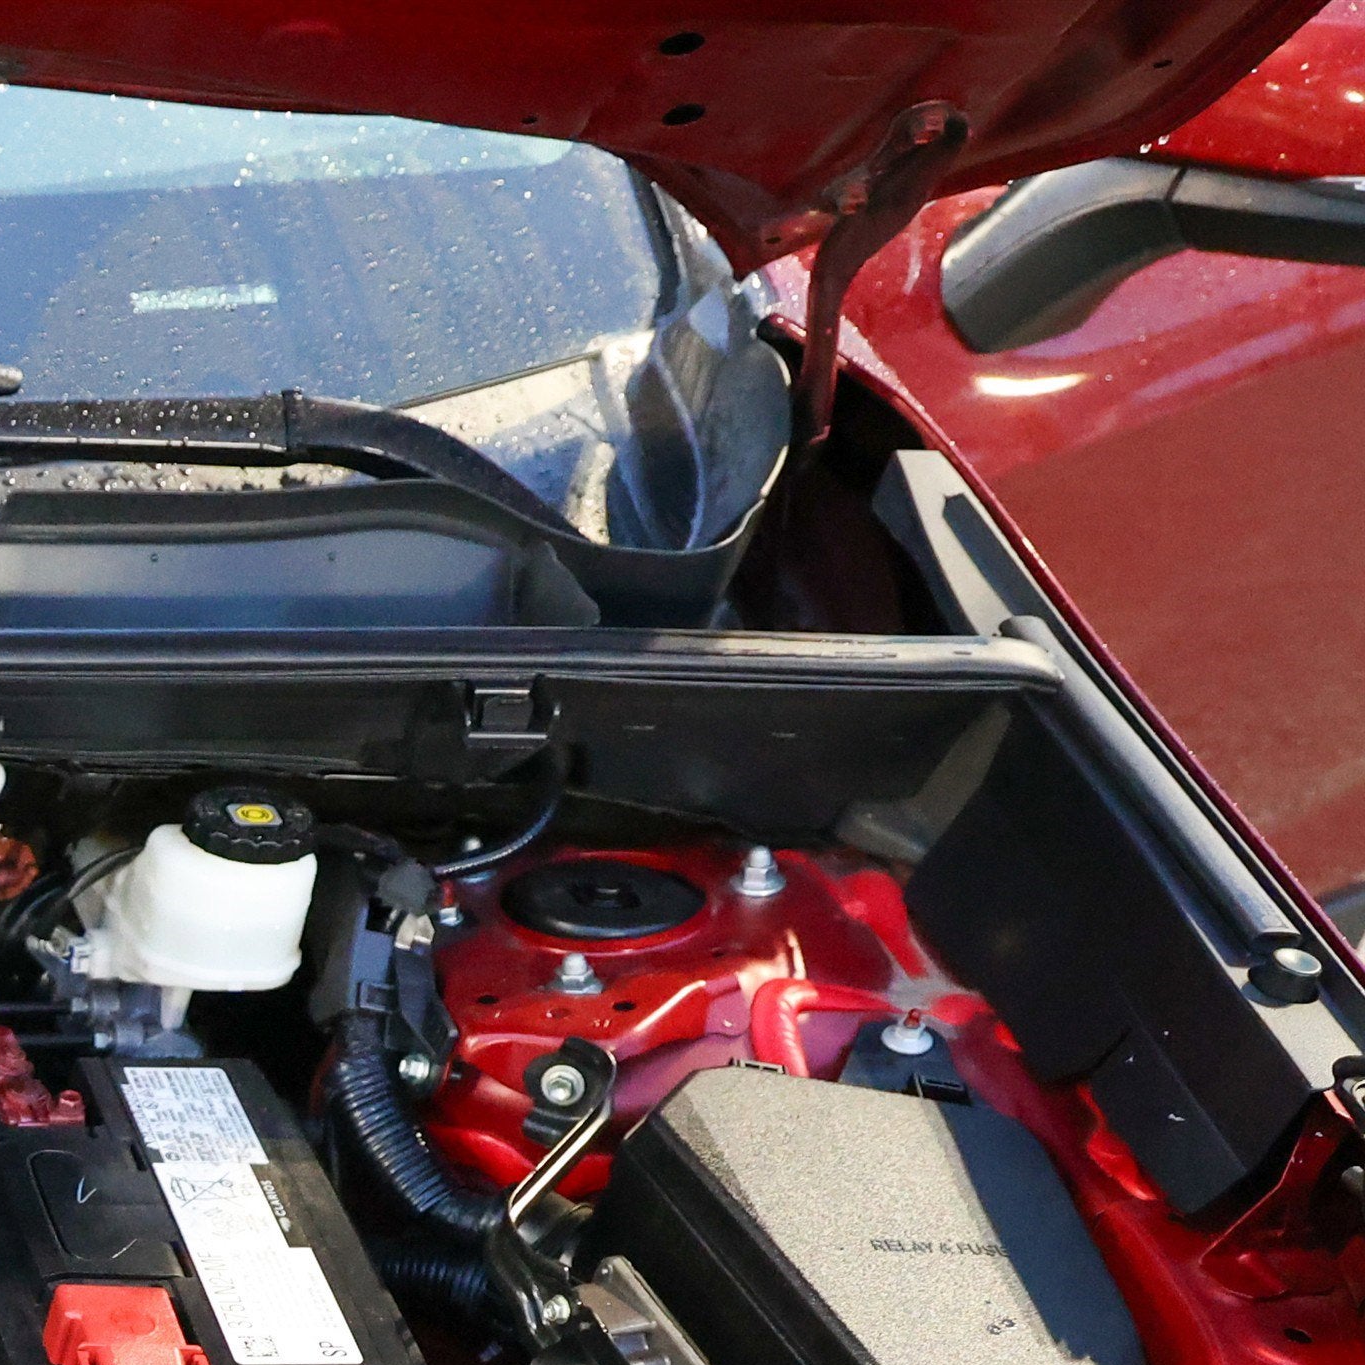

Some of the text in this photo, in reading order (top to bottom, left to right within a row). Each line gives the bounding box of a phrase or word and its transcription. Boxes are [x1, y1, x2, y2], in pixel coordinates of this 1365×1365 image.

[260, 1180, 287, 1217] CLARIOS
[870, 1238, 934, 1254] RELAY
[956, 1242, 1011, 1258] FUSE
[318, 1340, 348, 1358] SP
